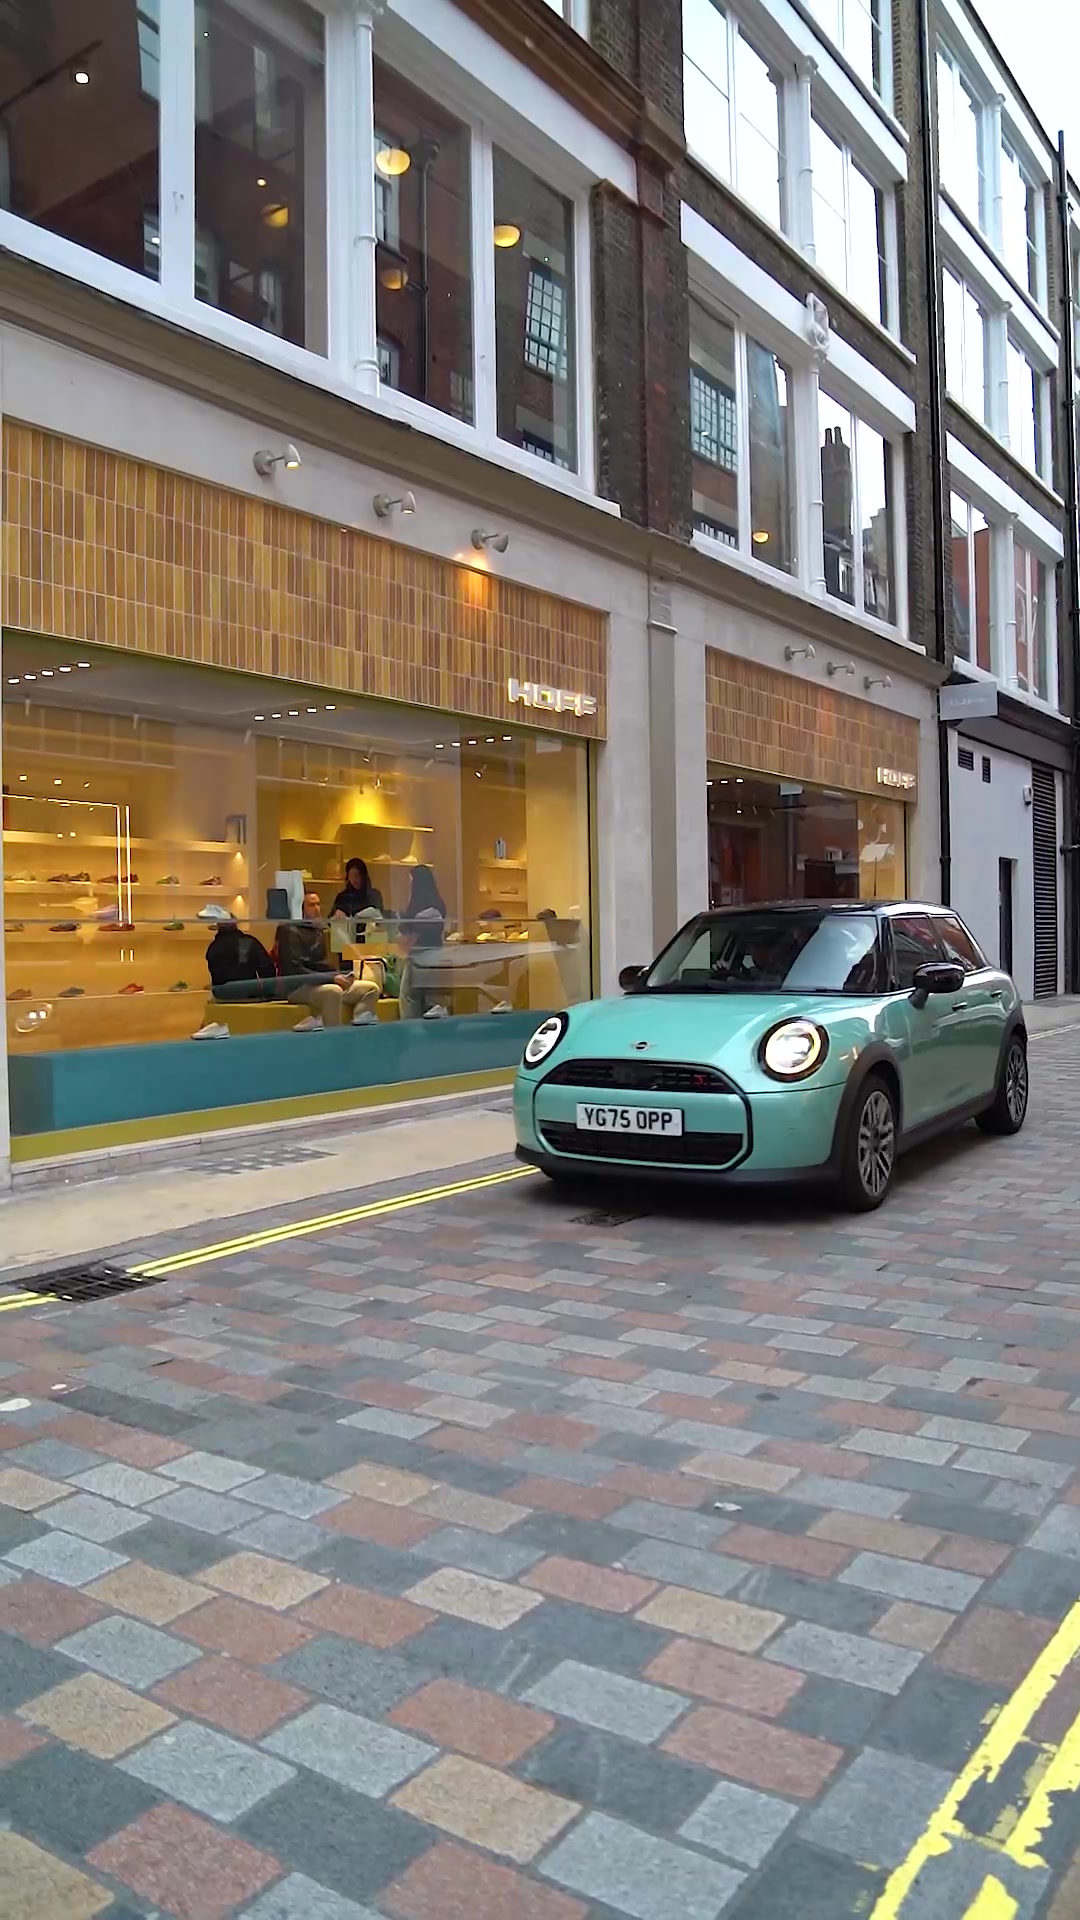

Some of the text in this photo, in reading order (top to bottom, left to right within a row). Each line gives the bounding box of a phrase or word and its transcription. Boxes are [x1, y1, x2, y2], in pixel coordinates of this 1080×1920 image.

[508, 678, 597, 716] HOFF
[584, 1107, 673, 1131] YG75 OPP
